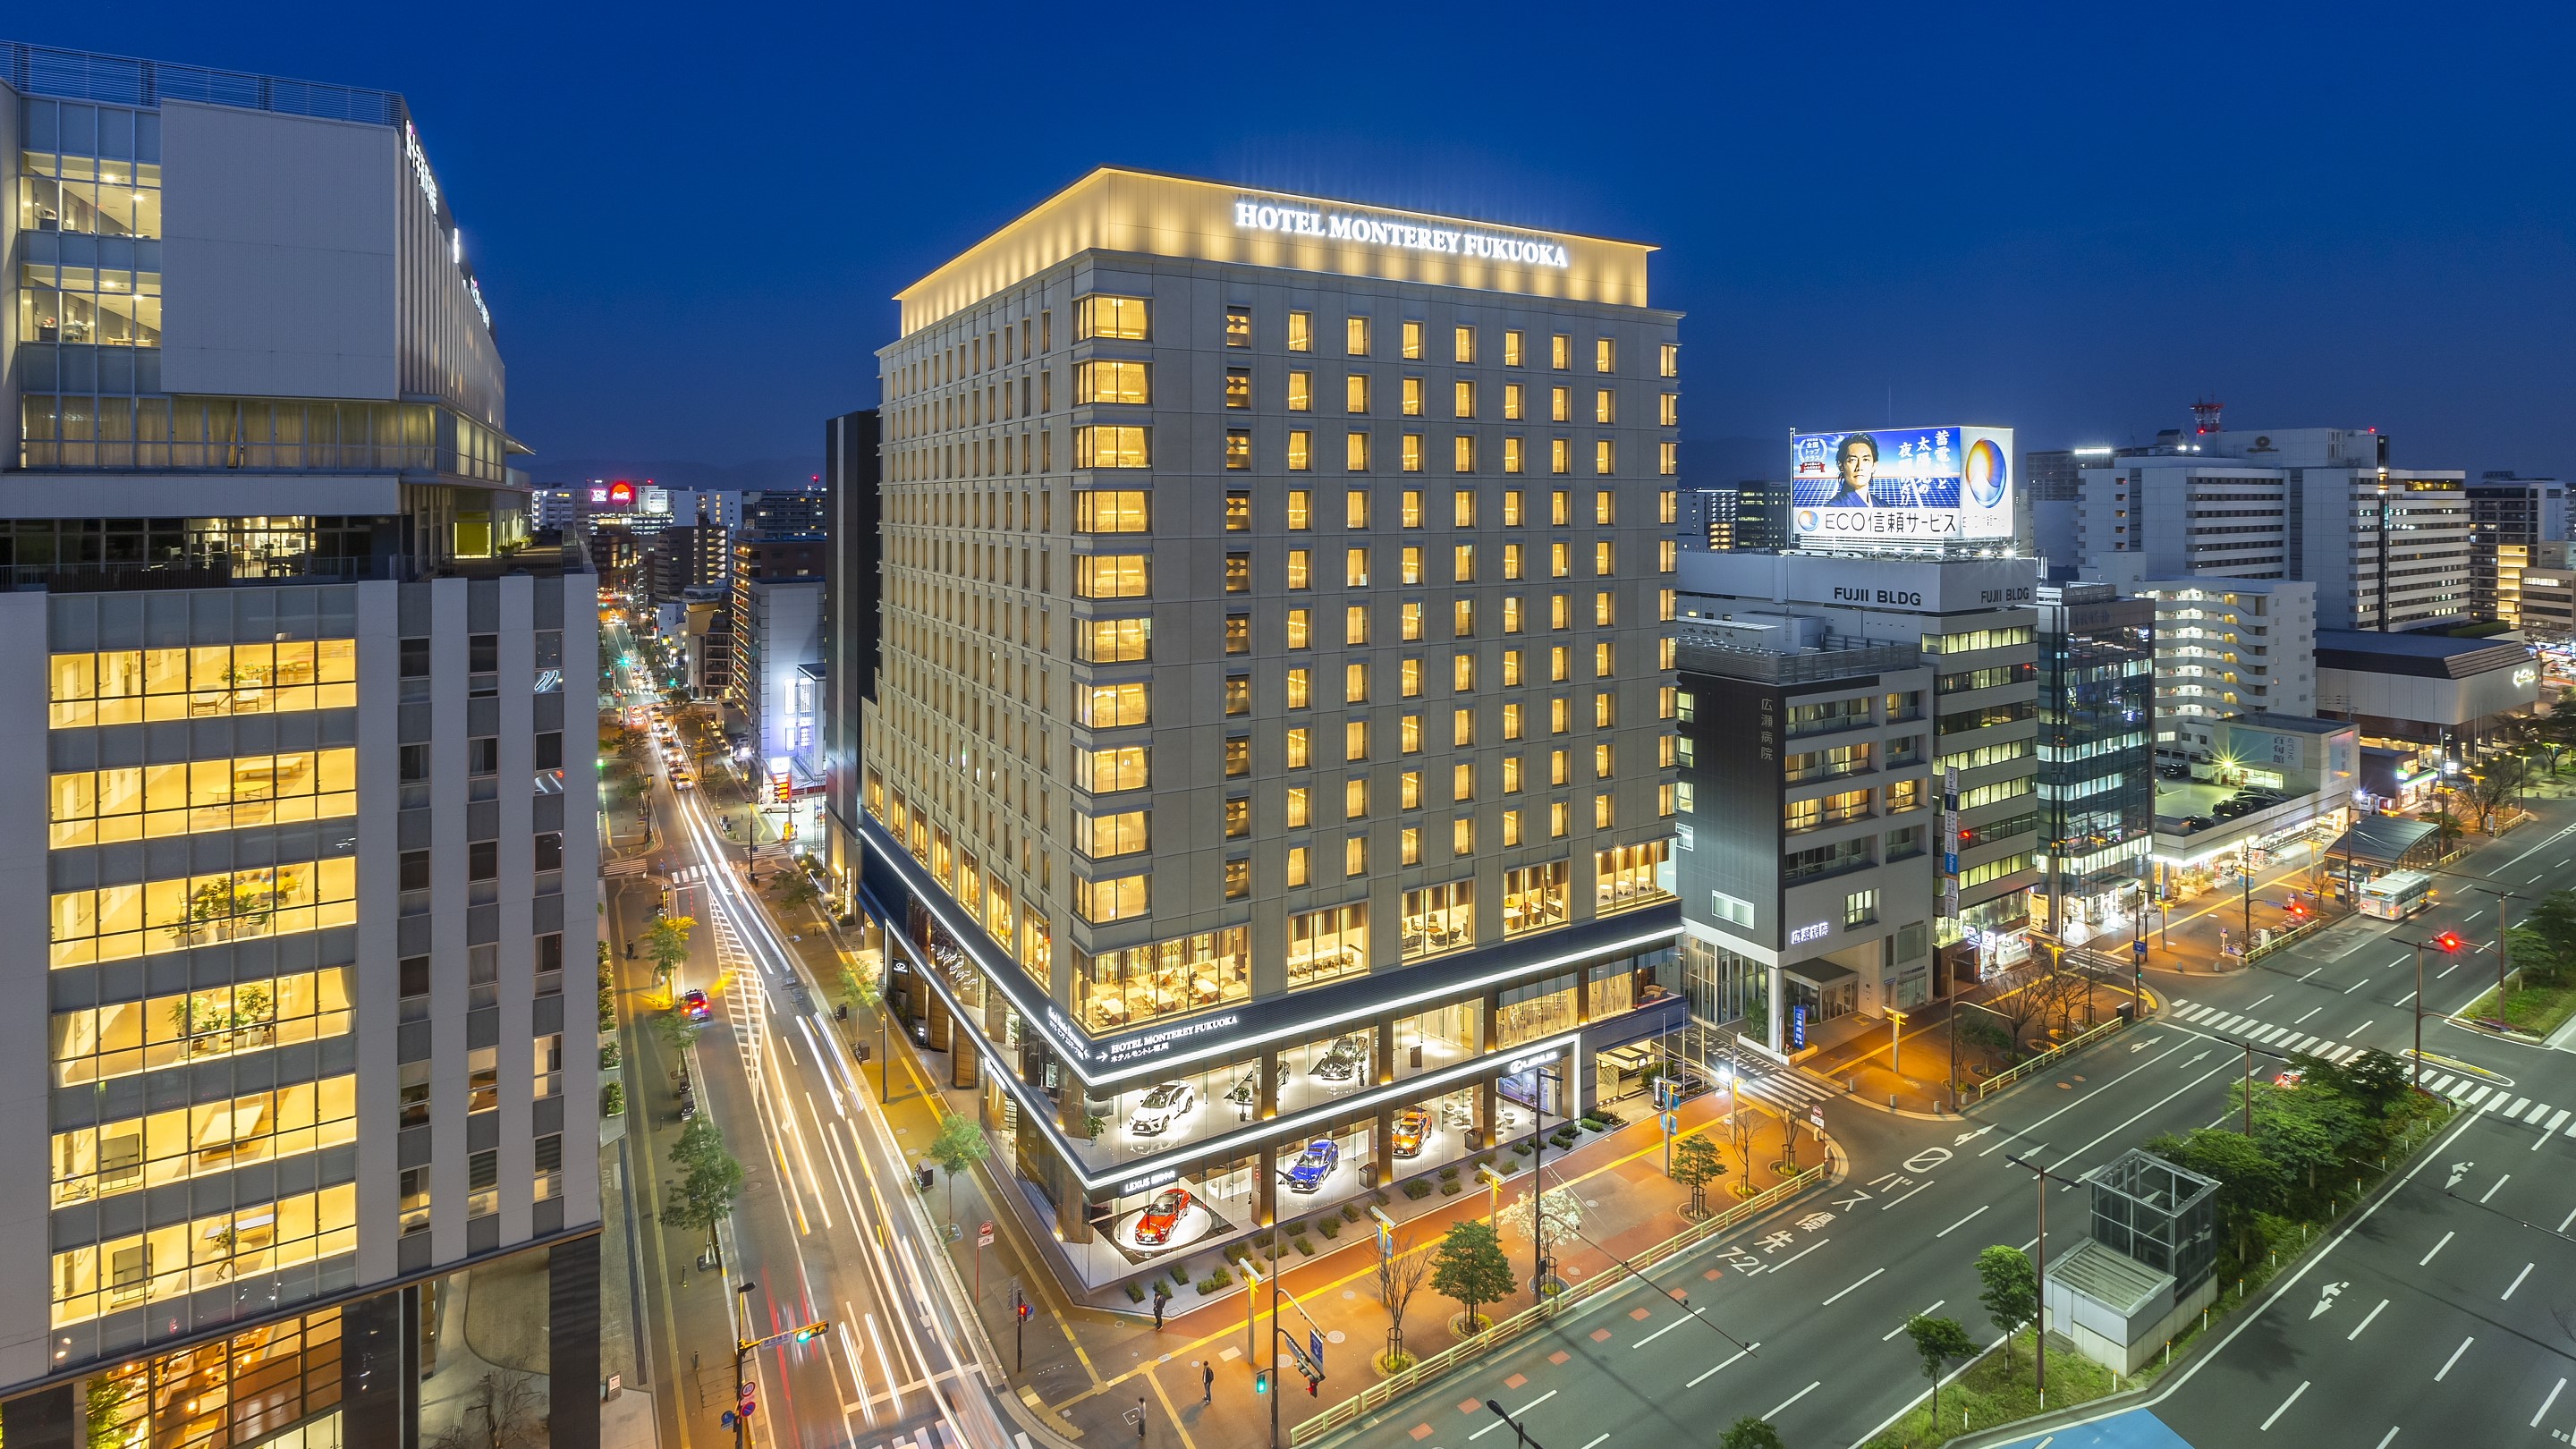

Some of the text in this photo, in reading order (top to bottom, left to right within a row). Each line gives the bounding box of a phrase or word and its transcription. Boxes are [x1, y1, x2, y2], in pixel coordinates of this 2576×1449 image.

[1235, 202, 1568, 267] HOTEL MONTEREY FUKUOKA
[1825, 512, 1956, 533] ECO信頼サービス
[1834, 587, 1921, 606] FUJII BLDG
[1980, 587, 2029, 604] FUJII BLDG
[1760, 698, 1773, 760] 広瀬病院
[1110, 1015, 1238, 1055] HOTEL MONTEREY FUKUOKA
[1124, 1177, 1150, 1192] LEXUS
